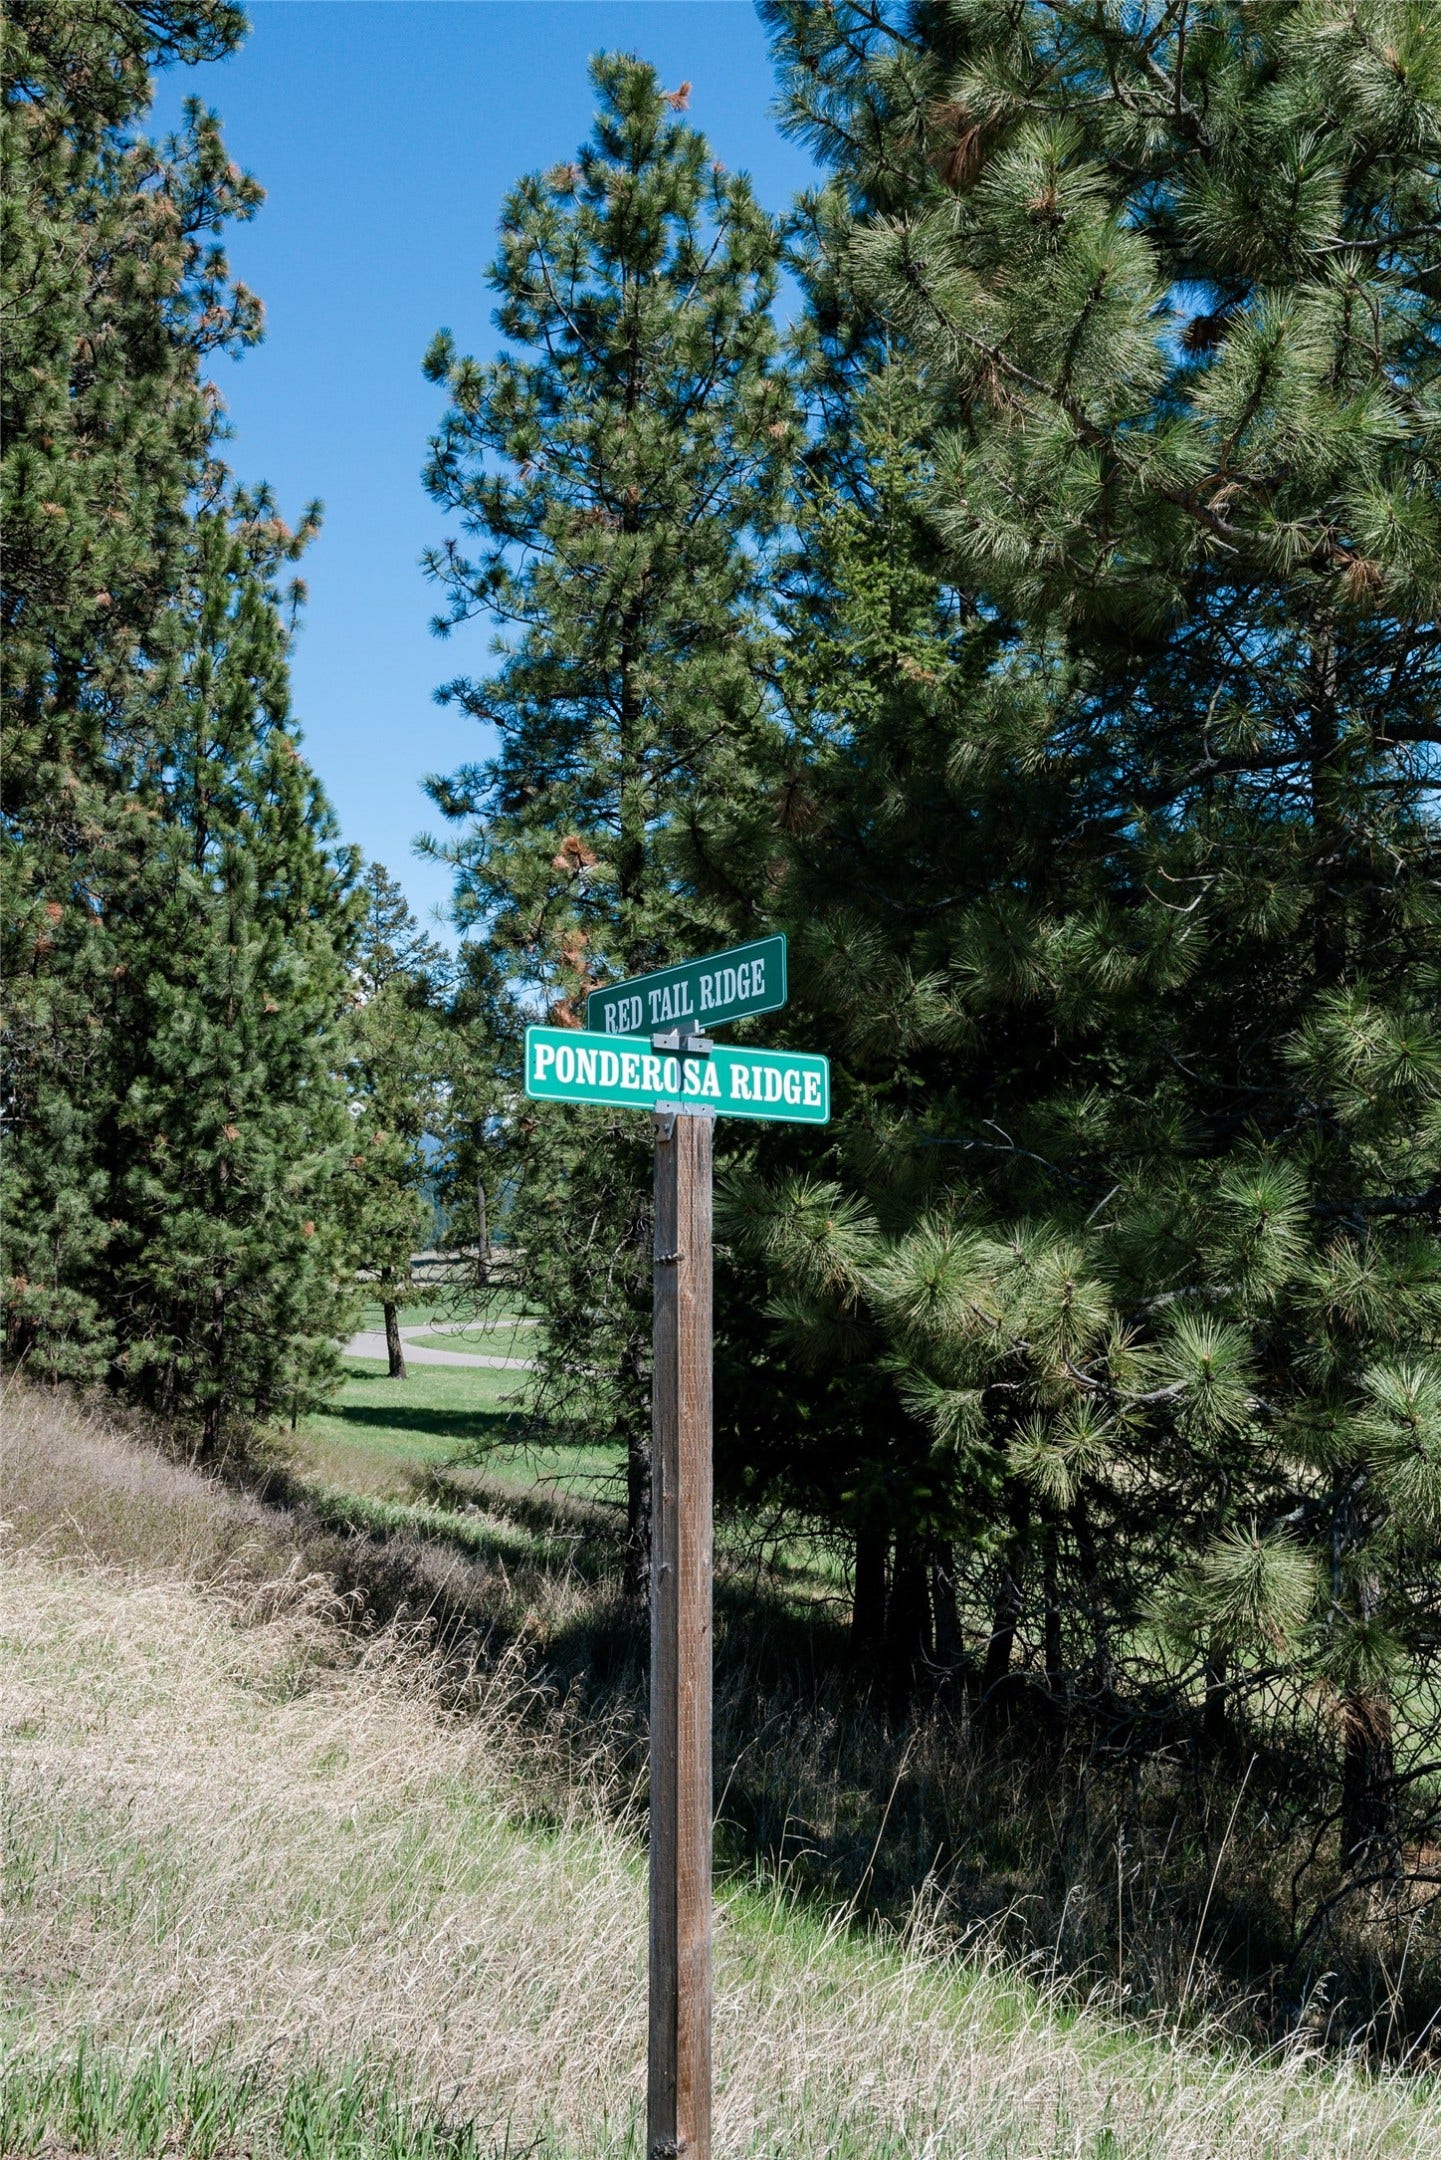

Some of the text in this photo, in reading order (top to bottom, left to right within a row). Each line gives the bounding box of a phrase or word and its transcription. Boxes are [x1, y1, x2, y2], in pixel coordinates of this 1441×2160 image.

[604, 958, 766, 1035] RED TAIL RIDGE
[533, 1043, 822, 1107] PONDEROSA RIDGE
